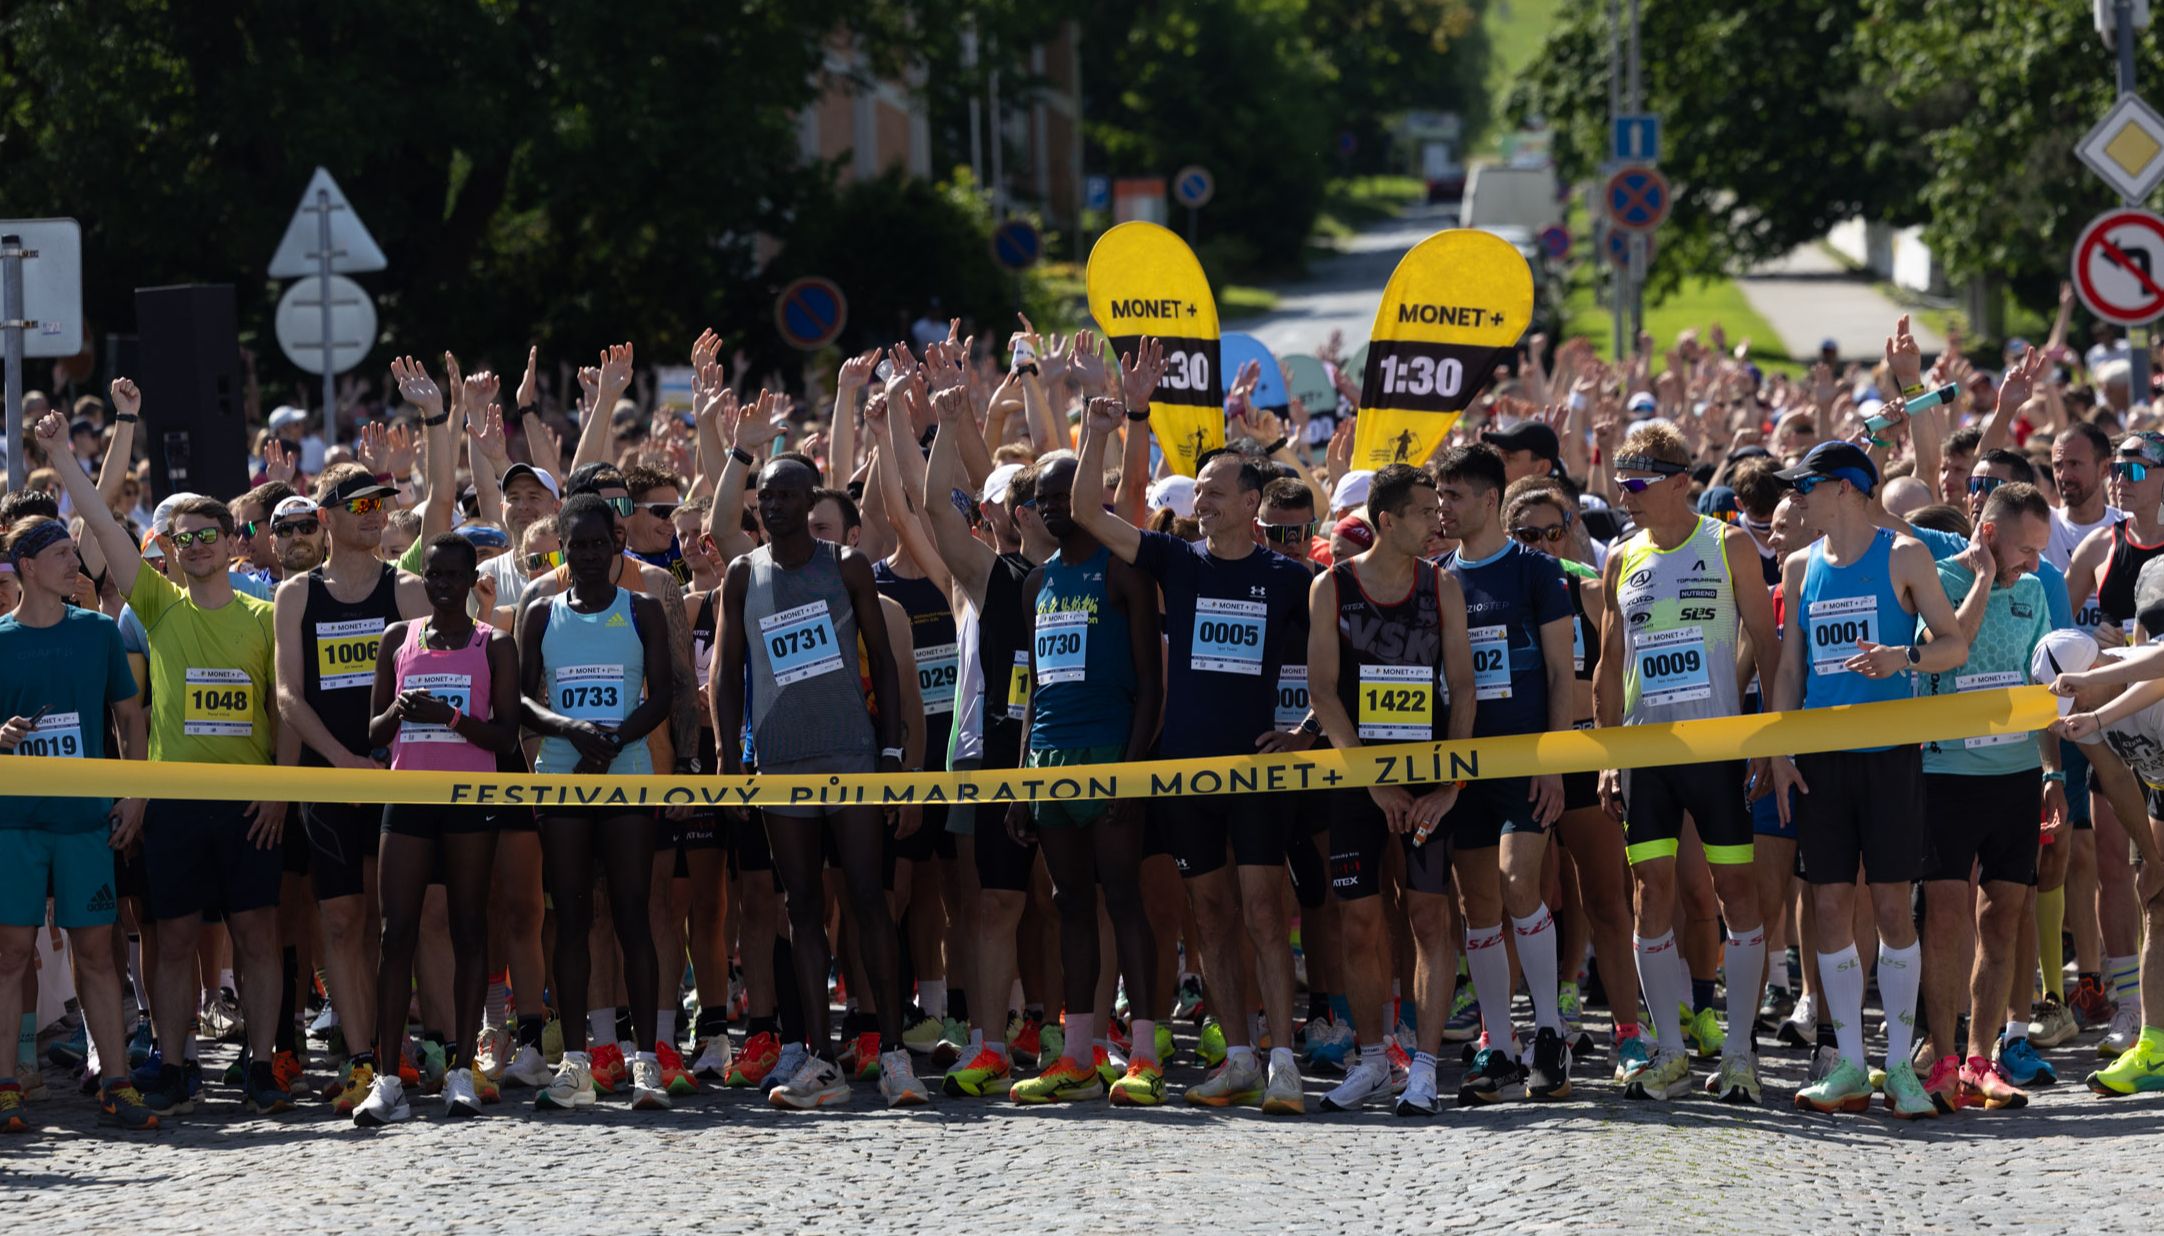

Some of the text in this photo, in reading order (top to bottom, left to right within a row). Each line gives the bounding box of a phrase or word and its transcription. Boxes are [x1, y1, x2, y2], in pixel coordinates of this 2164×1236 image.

[1111, 299, 1182, 319] MONET
[1398, 303, 1487, 328] MONET
[1380, 354, 1463, 398] 1:30
[1218, 601, 1244, 610] MONET
[1681, 590, 1716, 598] NUTREND
[1829, 600, 1854, 609] MONET
[338, 623, 363, 631] MONET
[1200, 621, 1259, 647] 0005
[1468, 630, 1484, 639] ONET
[1654, 631, 1679, 641] MONET
[1816, 619, 1870, 647] 0001
[324, 640, 380, 665] 1006
[772, 624, 828, 658] 0731
[1038, 633, 1081, 658] 0730
[575, 666, 601, 675] MONET
[1474, 648, 1504, 673] 02
[1642, 649, 1701, 679] 0009
[207, 670, 230, 679] MONET
[424, 675, 449, 684] MONET
[918, 665, 958, 689] 029
[192, 690, 248, 711] 1048
[562, 686, 618, 709] 0733
[1366, 689, 1426, 712] 1422
[20, 735, 77, 757] 0019
[1374, 743, 1480, 785] ZLÍN
